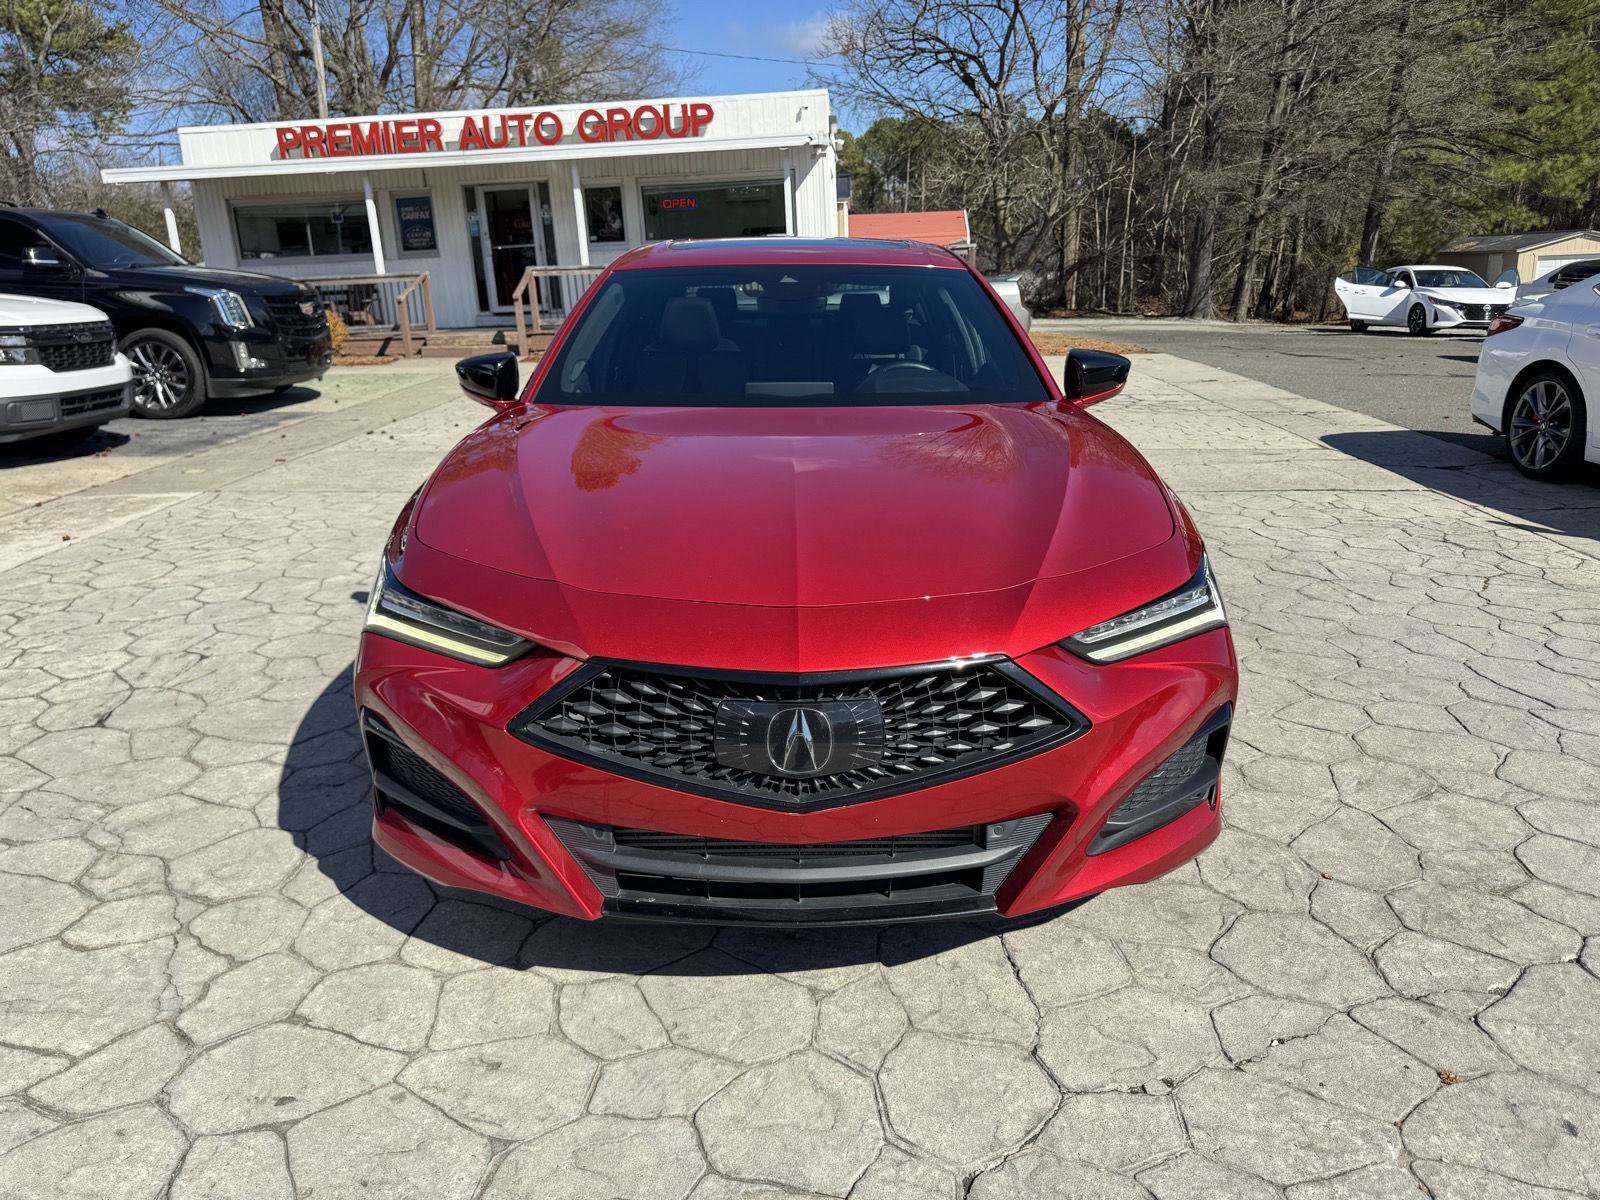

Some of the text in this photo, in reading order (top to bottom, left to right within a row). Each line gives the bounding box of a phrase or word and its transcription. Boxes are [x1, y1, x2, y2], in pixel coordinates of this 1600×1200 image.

[276, 103, 714, 160] PREMIER AUTO GROUP
[662, 198, 696, 209] OPEN
